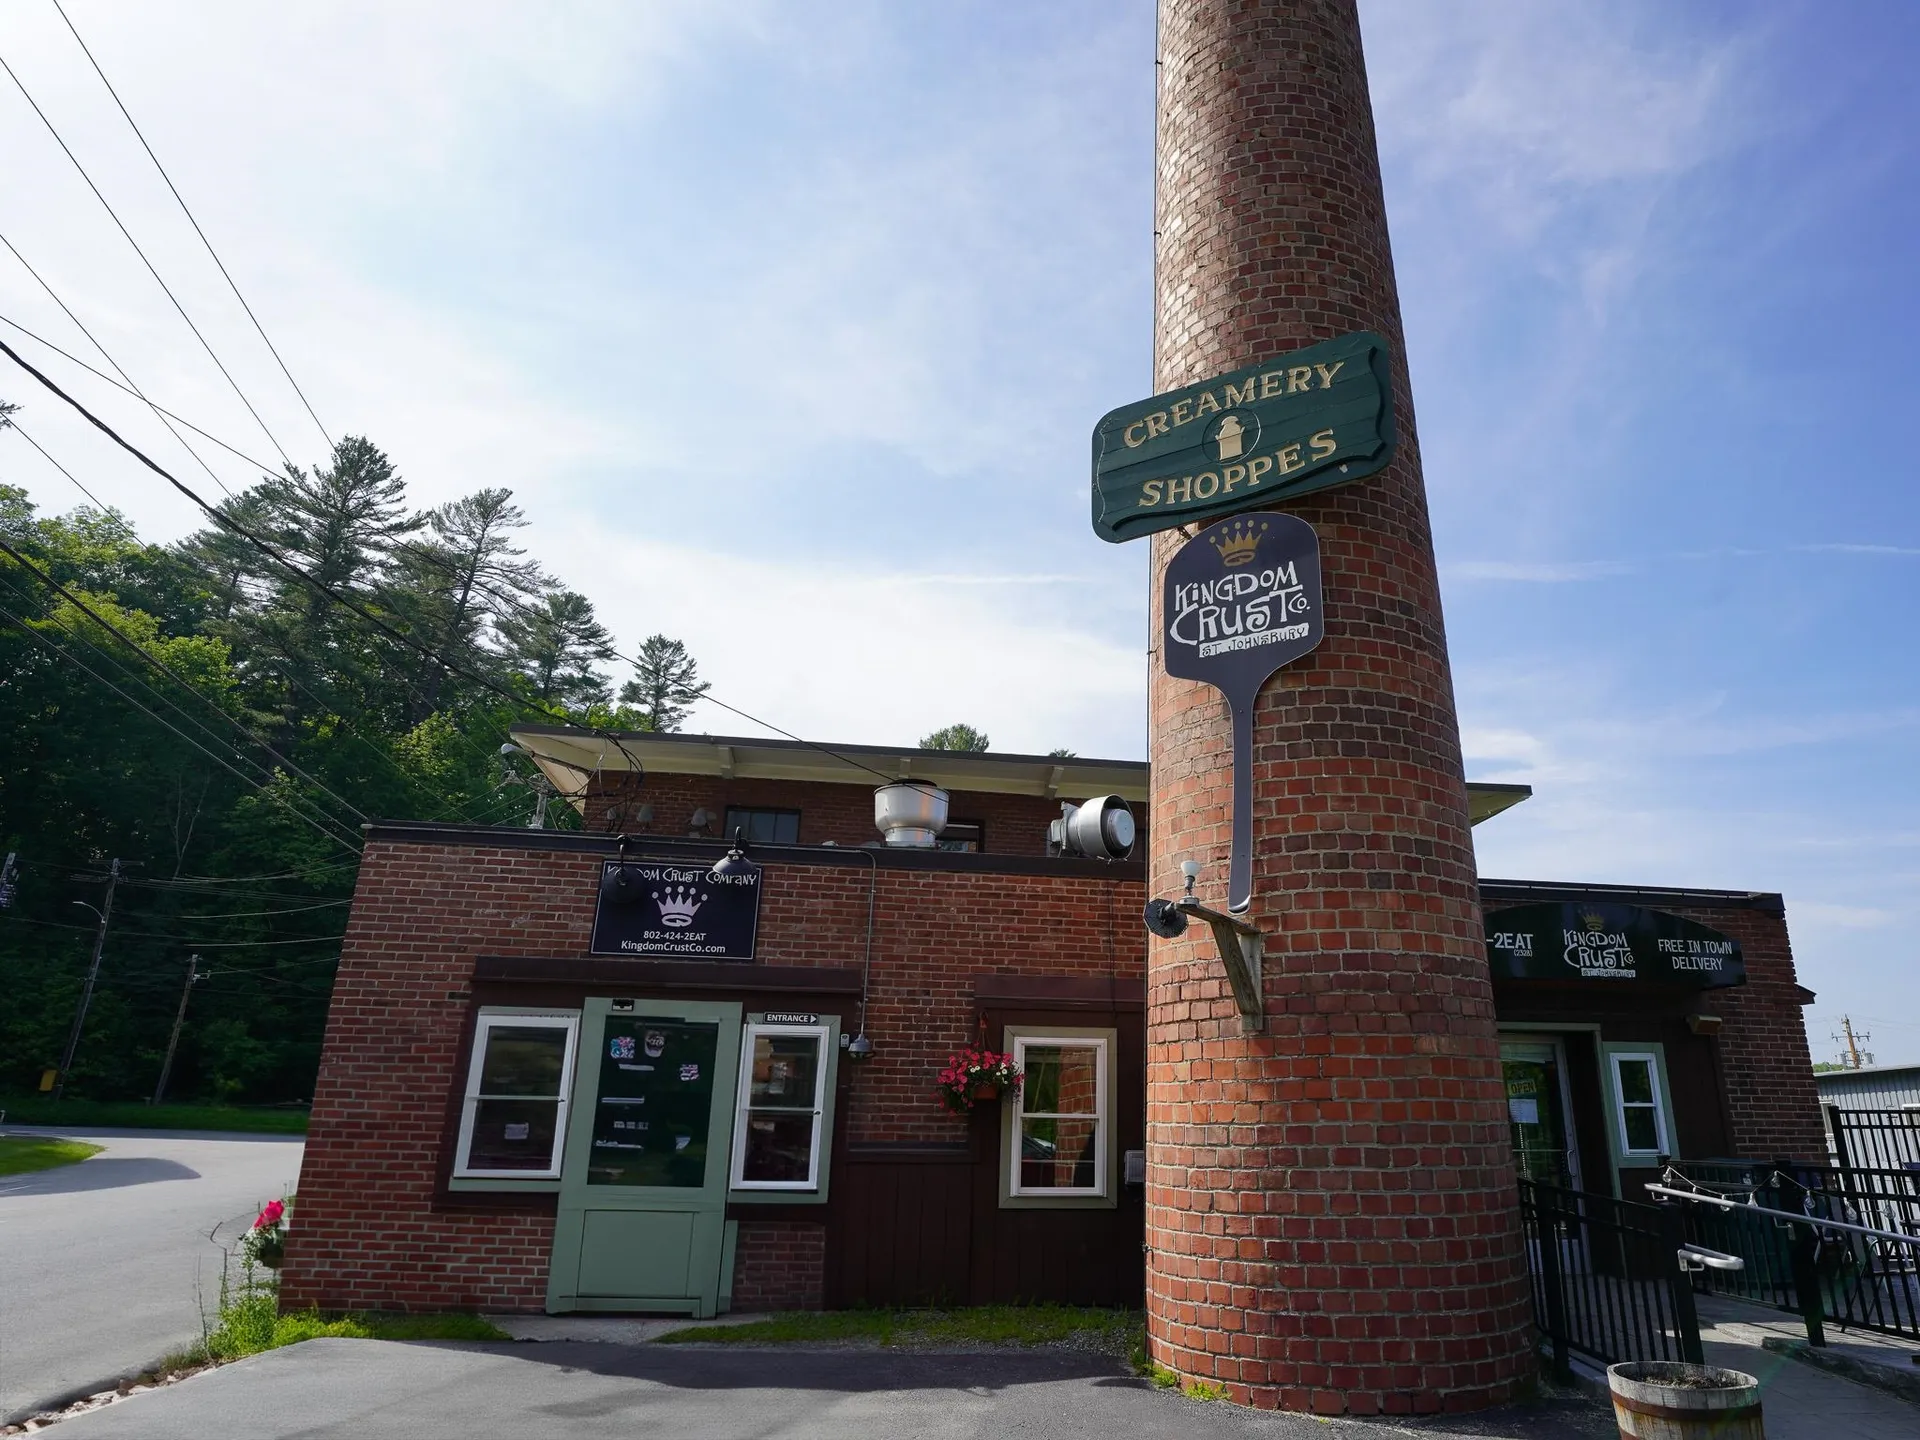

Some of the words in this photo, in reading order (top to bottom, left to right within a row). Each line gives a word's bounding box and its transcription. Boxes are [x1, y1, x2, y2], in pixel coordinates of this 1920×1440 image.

[1123, 360, 1344, 448] CREAMERY
[1138, 428, 1337, 507] SHOPPES
[1170, 585, 1303, 645] CRUST
[1229, 627, 1306, 650] JOHNSBURY
[643, 931, 707, 941] 802-424-2EAT
[621, 940, 726, 953] KingdomCrustCo.com
[1658, 939, 1685, 952] FREE
[1687, 940, 1700, 953] IN
[1703, 941, 1732, 954] TOWN
[1564, 946, 1630, 969] CRUST
[1671, 956, 1722, 970] DELIVERY
[766, 1013, 808, 1022] ENTRANCE
[1511, 1082, 1536, 1094] OPEN
